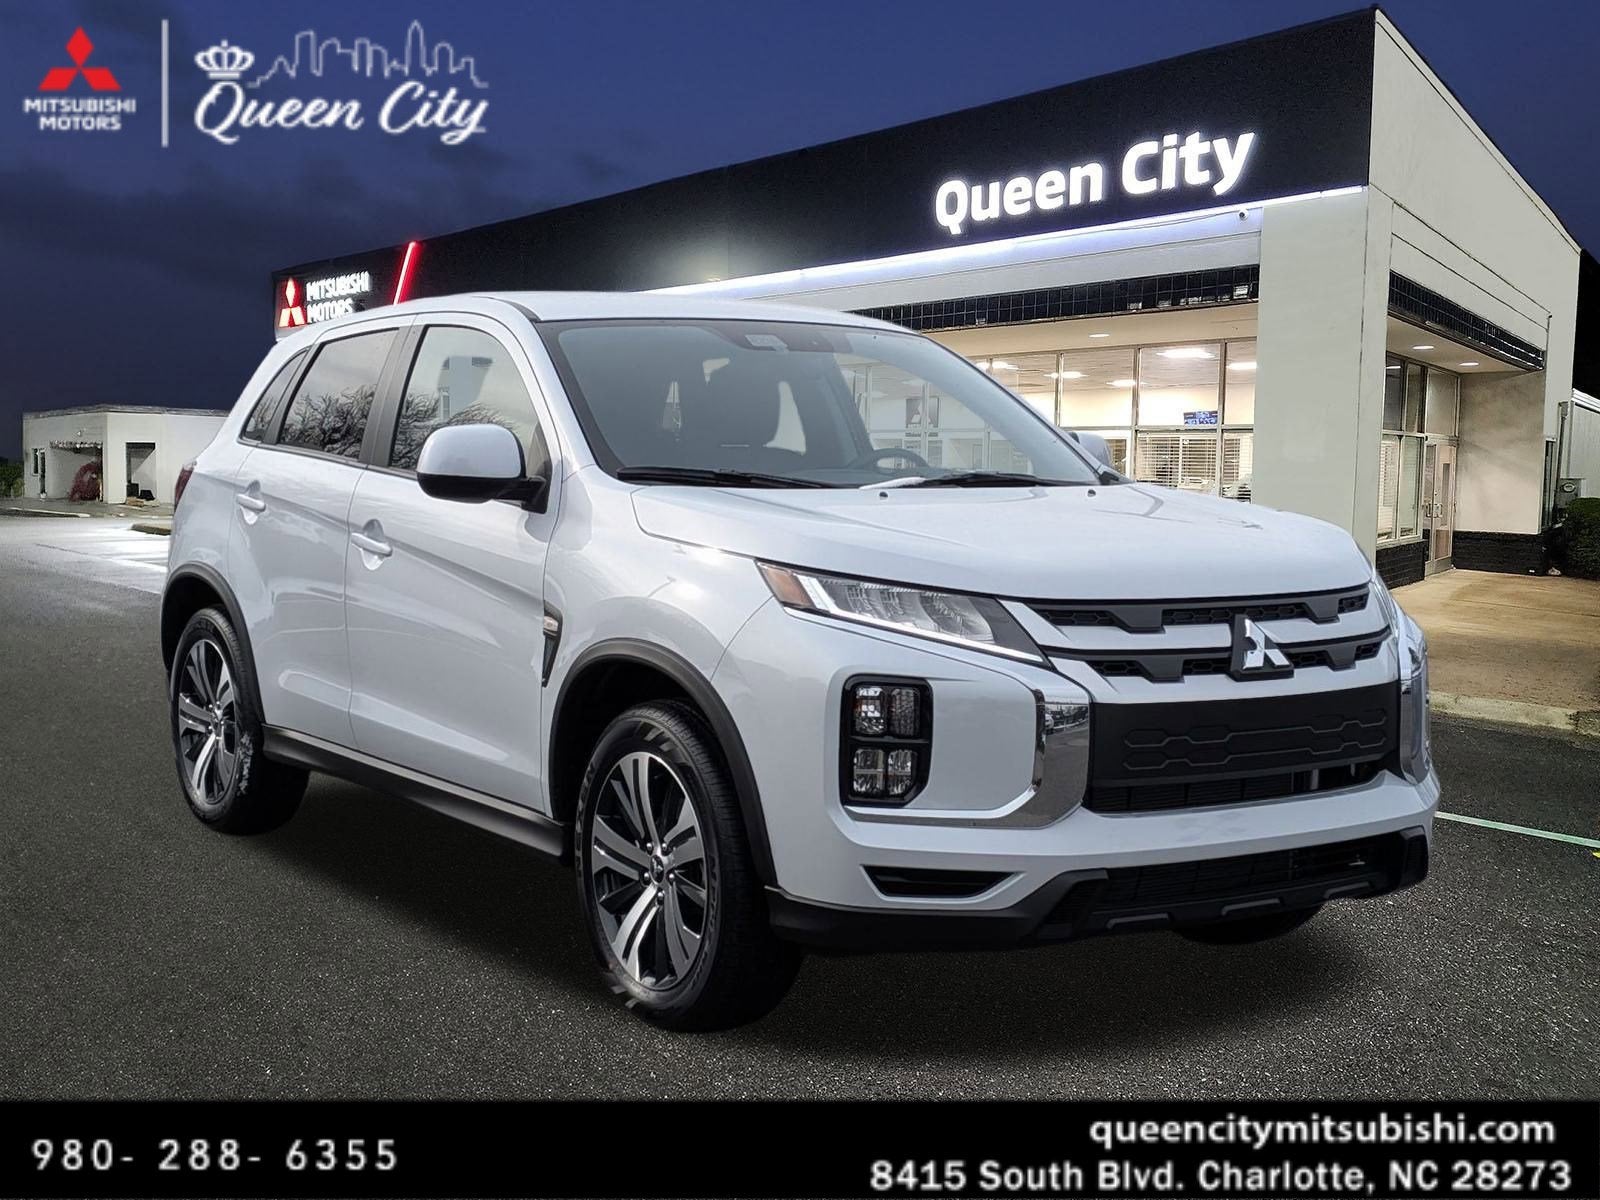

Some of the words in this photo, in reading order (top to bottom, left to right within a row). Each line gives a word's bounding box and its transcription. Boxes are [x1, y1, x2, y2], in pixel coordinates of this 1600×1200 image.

[935, 161, 1103, 235] Queen
[1121, 131, 1255, 196] City
[306, 271, 370, 301] MITSUBISHI
